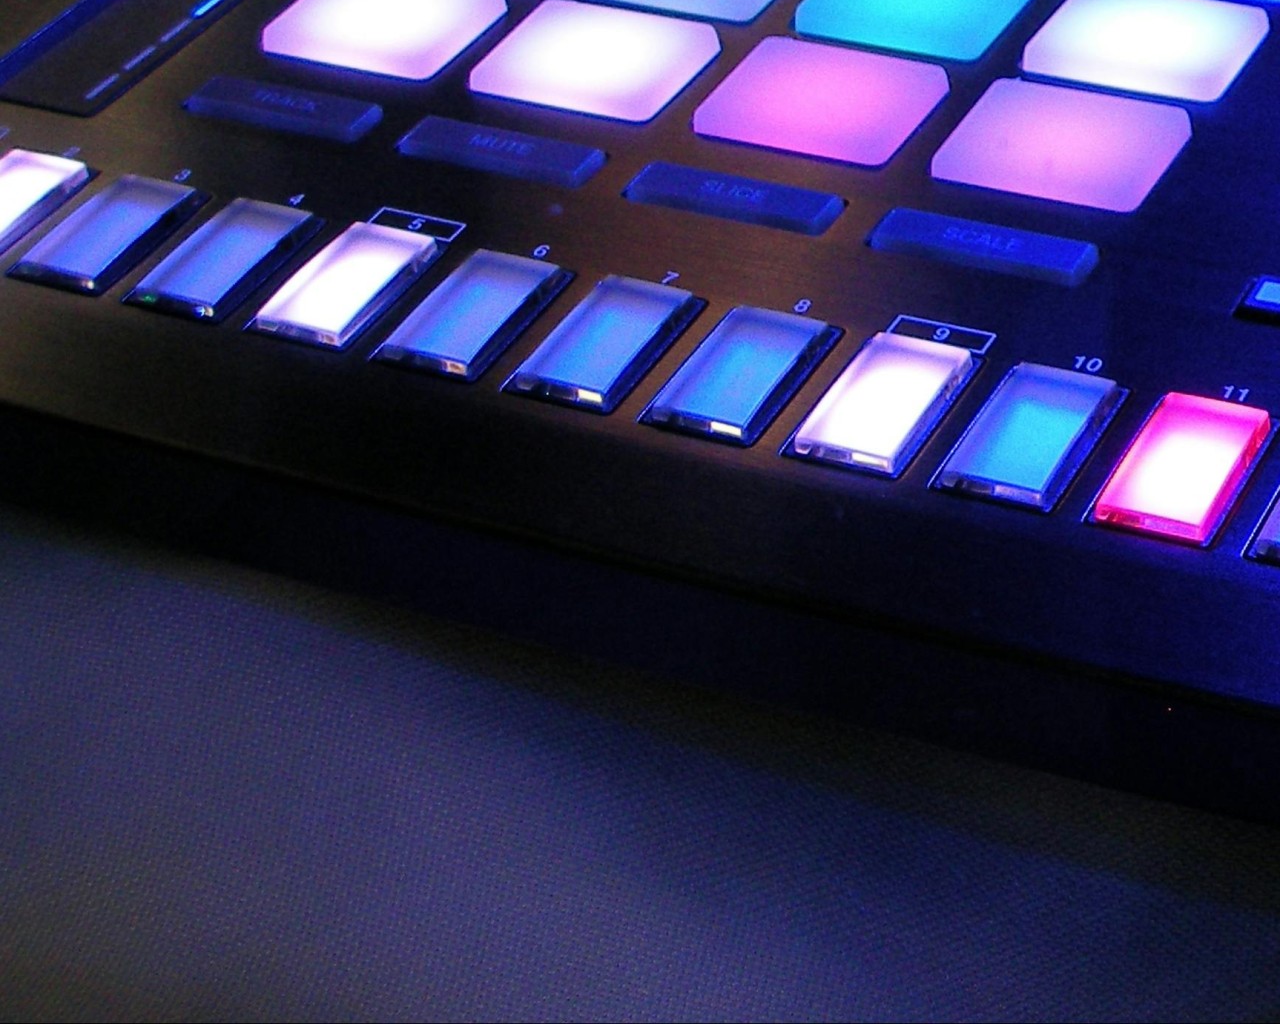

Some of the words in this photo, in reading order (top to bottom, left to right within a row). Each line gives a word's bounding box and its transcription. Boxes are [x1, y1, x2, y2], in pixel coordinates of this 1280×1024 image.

[469, 132, 535, 157] MUTE
[702, 179, 769, 204] SLICE
[407, 217, 425, 232] 5
[941, 226, 1021, 252] SCALE
[532, 243, 550, 259] 6
[661, 270, 680, 284] 7
[793, 298, 811, 314] 8
[932, 327, 951, 343] 9
[1073, 354, 1103, 373] 10
[1222, 385, 1250, 403] 11
